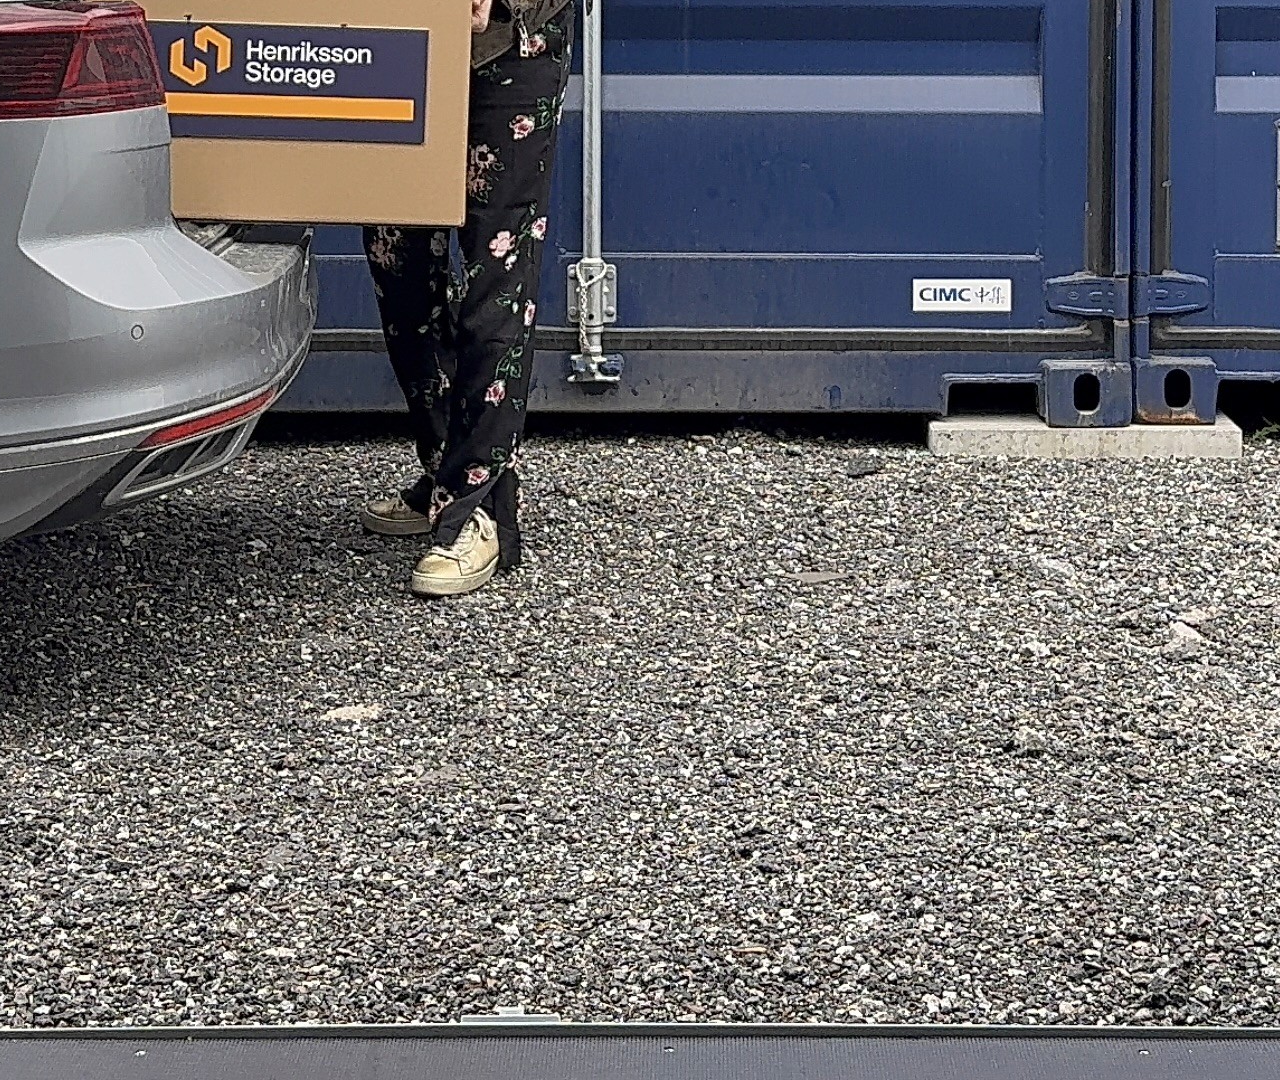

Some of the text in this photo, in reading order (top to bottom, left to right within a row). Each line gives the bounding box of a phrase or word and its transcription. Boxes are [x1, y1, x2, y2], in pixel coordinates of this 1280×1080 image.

[246, 39, 372, 63] Henriksson
[245, 62, 336, 88] Storage
[919, 287, 971, 302] CIMC
